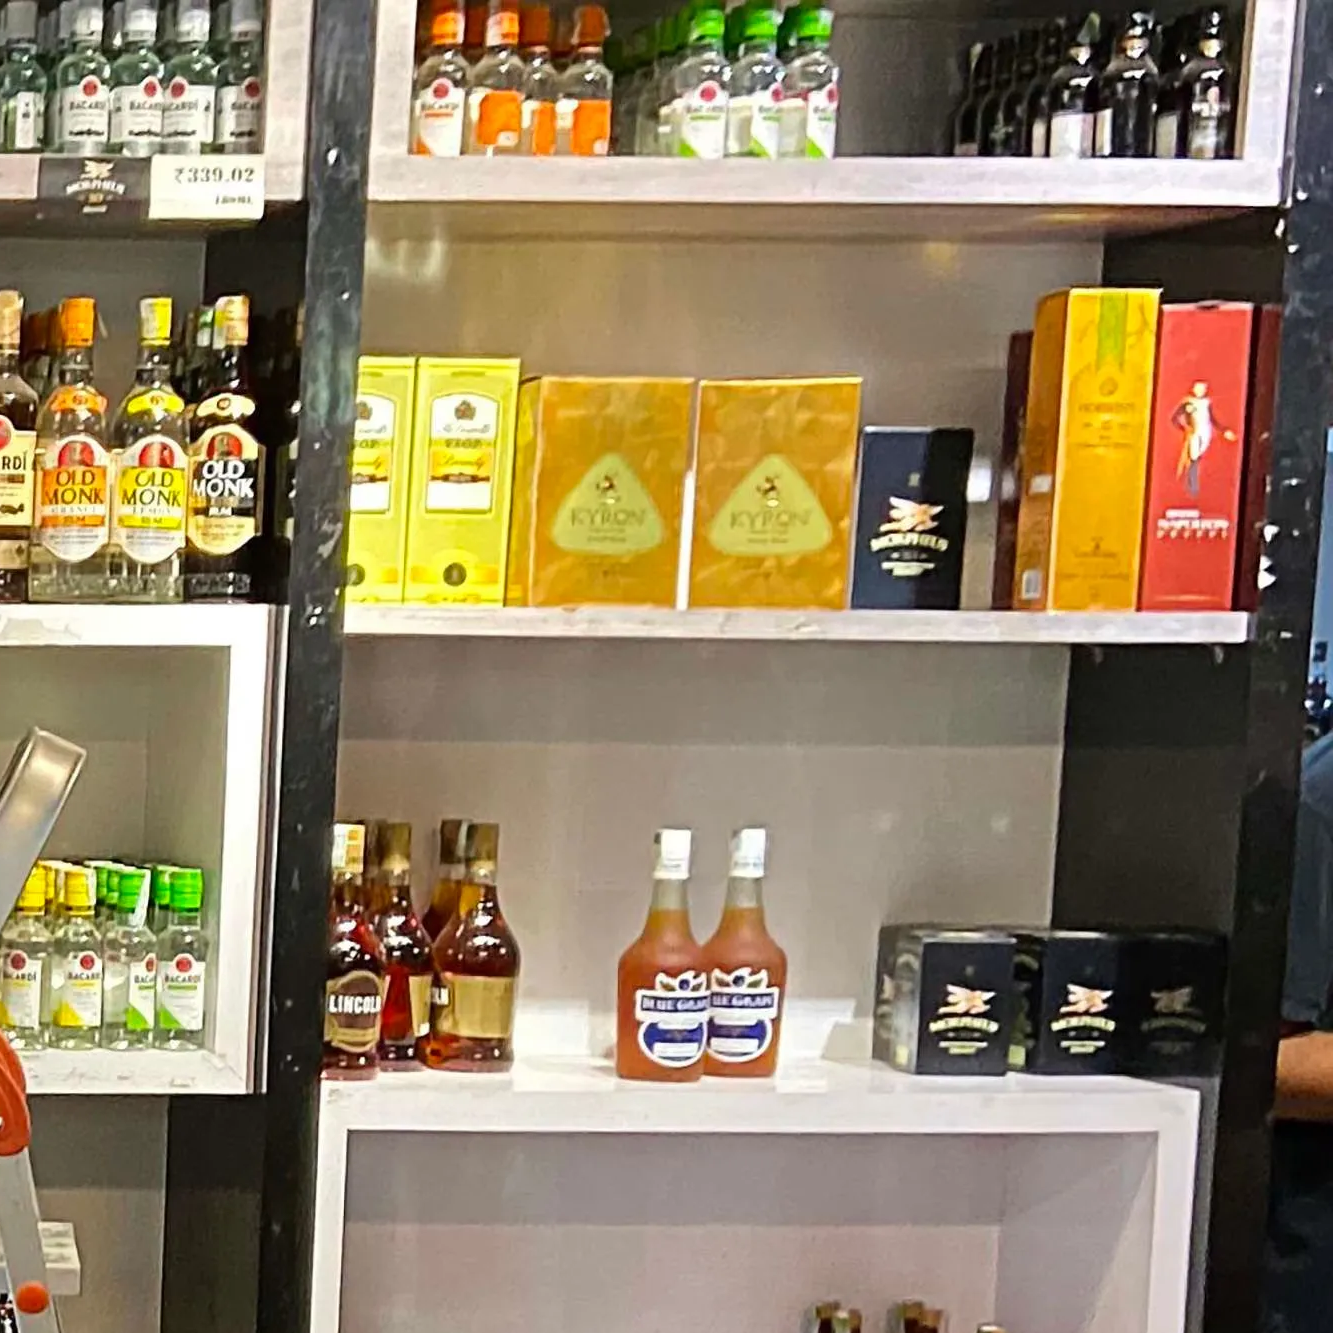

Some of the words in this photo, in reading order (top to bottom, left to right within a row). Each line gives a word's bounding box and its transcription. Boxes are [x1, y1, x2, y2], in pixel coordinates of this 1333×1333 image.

[55, 469, 96, 486] OLD
[202, 459, 245, 479] OLD
[134, 470, 174, 488] OLD
[193, 478, 254, 498] MONK
[45, 487, 103, 505] MONK
[121, 488, 181, 507] MONK
[570, 507, 648, 528] KYRON
[730, 508, 812, 529] KYRON
[328, 994, 381, 1013] LINCOL
